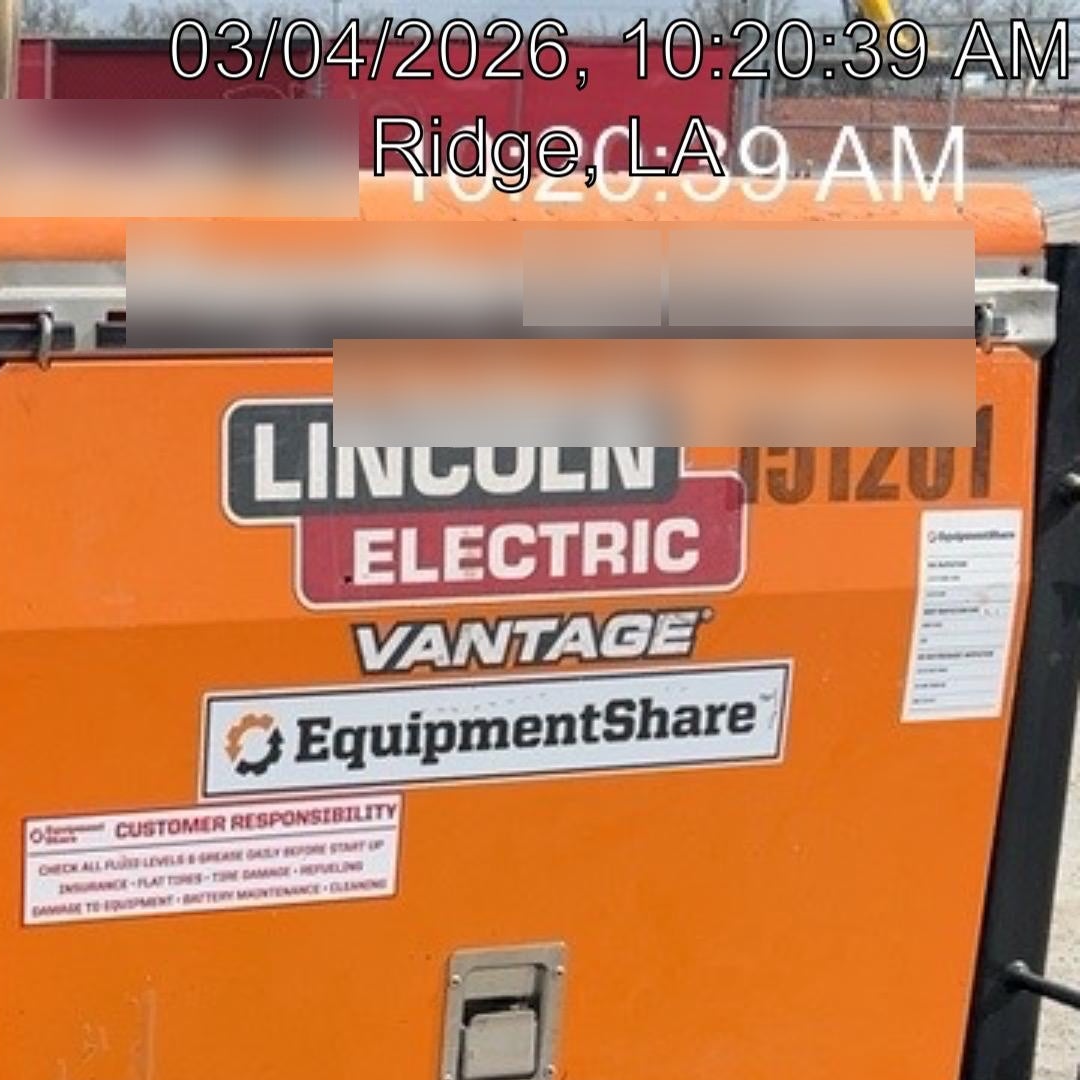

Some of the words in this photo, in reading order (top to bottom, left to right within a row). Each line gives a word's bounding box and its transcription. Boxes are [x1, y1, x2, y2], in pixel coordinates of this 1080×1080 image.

[353, 518, 700, 586] ELECTRIC
[352, 610, 702, 674] VANTAGE
[294, 697, 757, 770] EquipmentShare
[116, 816, 226, 839] CUSTOMER
[231, 804, 397, 831] RESPONSIBILITY
[39, 861, 78, 876] CHECK
[82, 860, 102, 873] ALL
[144, 855, 184, 869] LEVELS
[199, 851, 243, 864] GREASE
[284, 844, 326, 857] BEFORE
[330, 840, 365, 854] START
[368, 840, 385, 850] UP
[59, 880, 127, 895] INSURANCE
[137, 875, 165, 888] FLAT
[105, 895, 172, 912] EQUIPMENT
